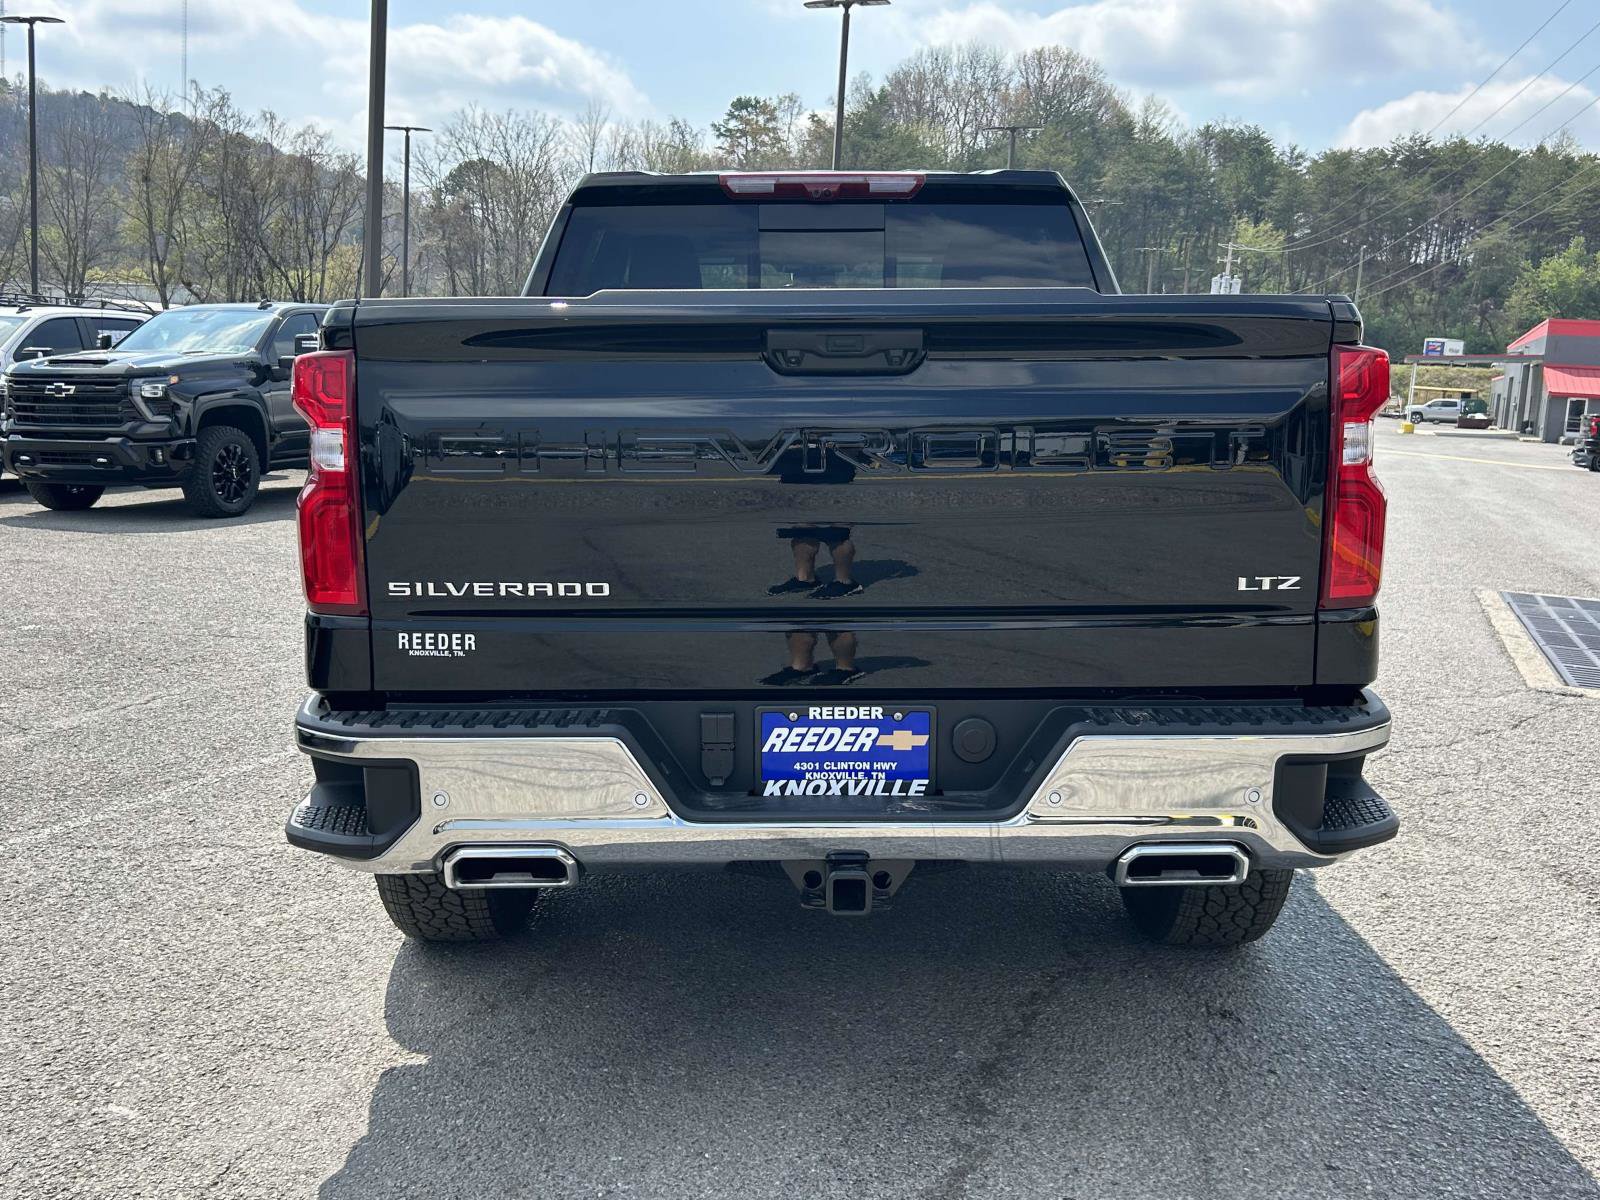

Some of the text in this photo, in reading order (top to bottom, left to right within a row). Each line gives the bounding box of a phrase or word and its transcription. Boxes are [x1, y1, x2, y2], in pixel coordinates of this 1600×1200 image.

[388, 582, 610, 596] SILVERADO
[1237, 576, 1301, 591] LTZ
[398, 633, 476, 650] REEDER
[809, 706, 883, 720] REEDER
[762, 727, 879, 752] REEDER
[794, 762, 898, 770] 4301 CLINTON HWY
[871, 772, 885, 780] TN
[763, 779, 929, 796] KNOXVILLE
